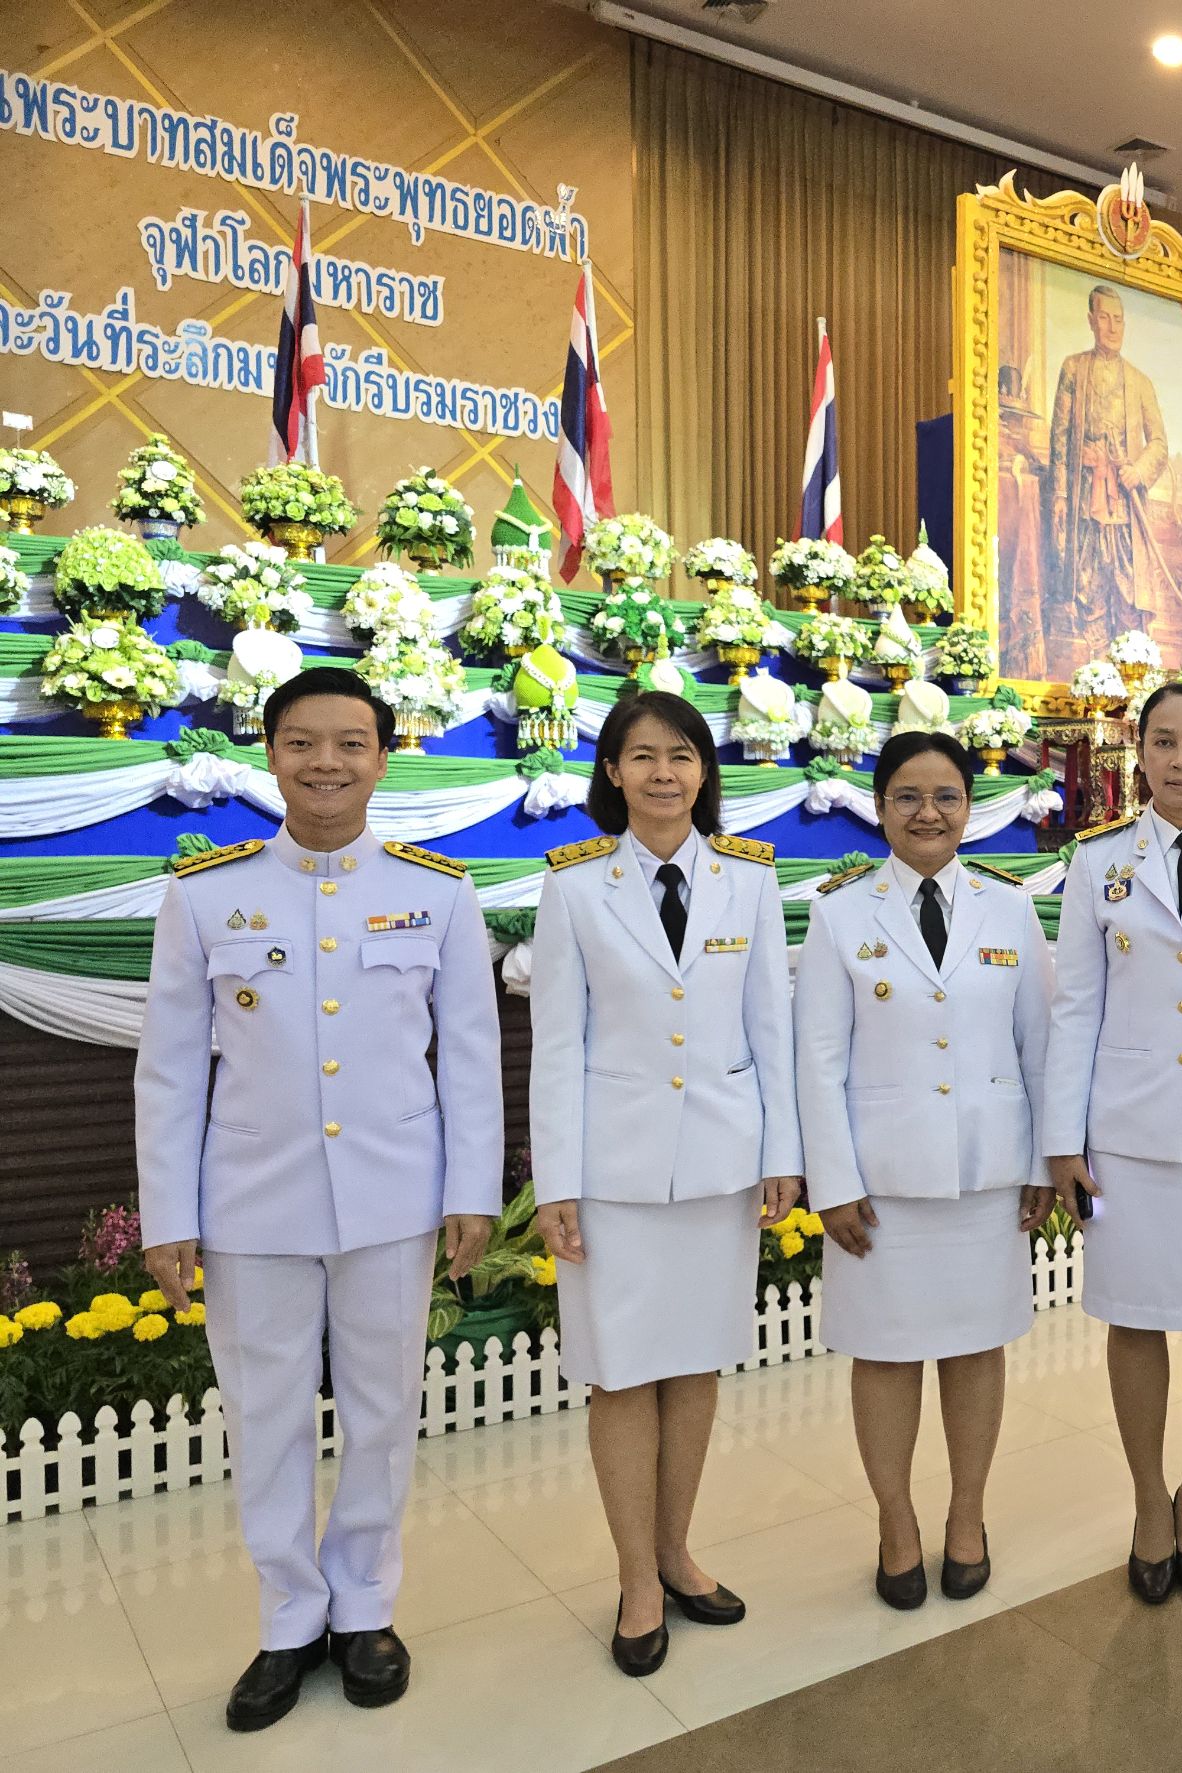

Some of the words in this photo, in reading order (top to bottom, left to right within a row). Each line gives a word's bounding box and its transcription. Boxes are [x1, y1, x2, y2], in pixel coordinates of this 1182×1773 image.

[0, 291, 559, 438] ะวันที่ระลึกมจักรีบรมราชวง
